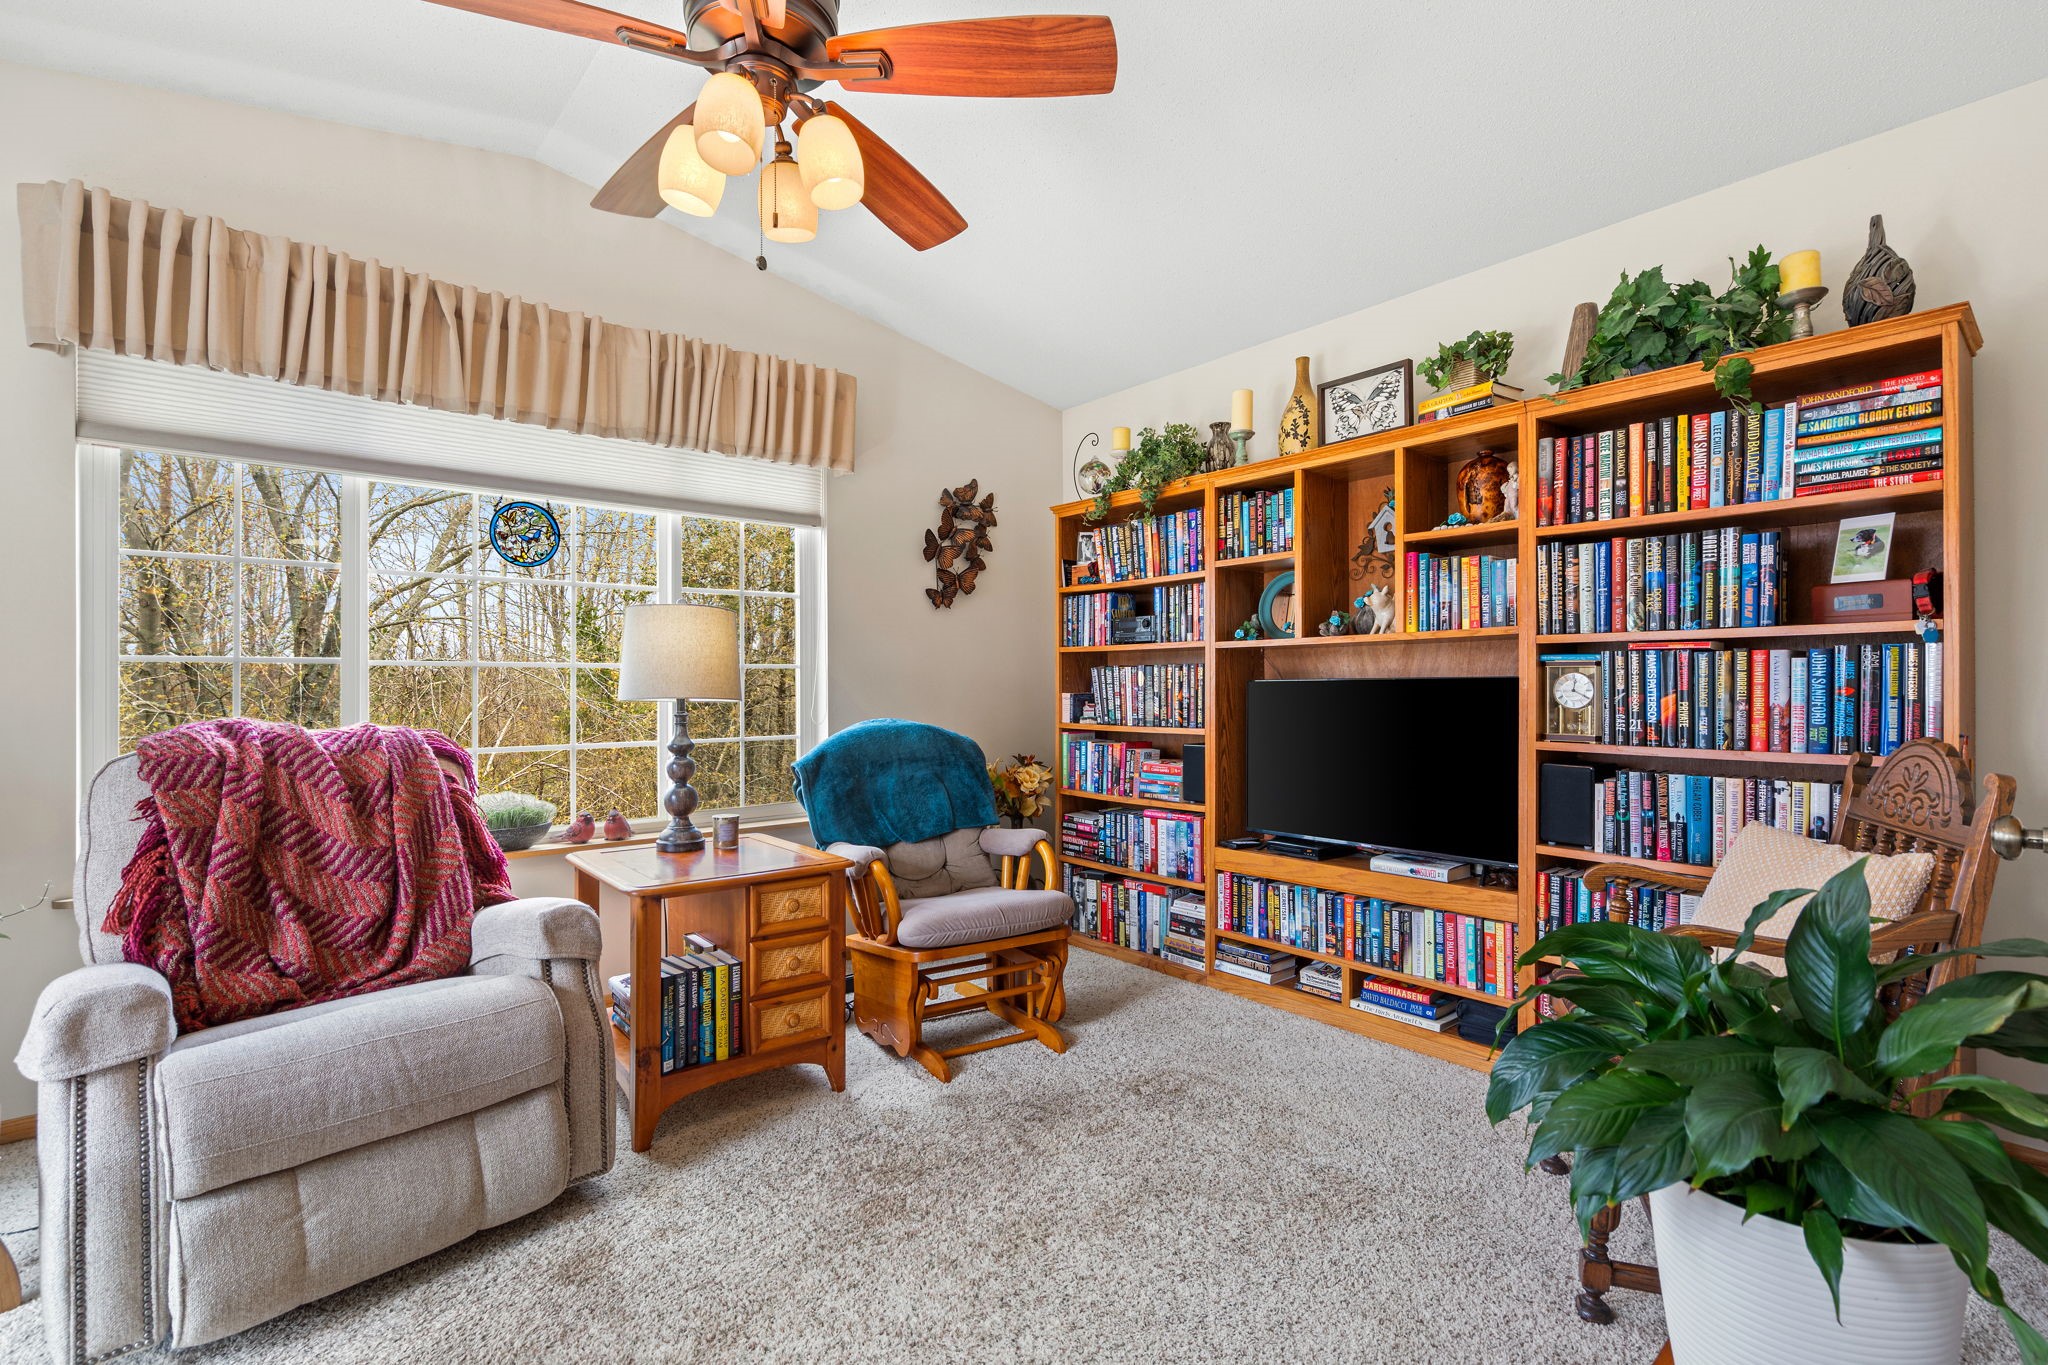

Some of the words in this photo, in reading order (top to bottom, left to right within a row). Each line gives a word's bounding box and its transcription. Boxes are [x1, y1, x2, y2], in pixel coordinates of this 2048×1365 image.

[1885, 379, 1896, 387] THE
[1898, 374, 1925, 384] HANGED
[1801, 394, 1824, 406] JOHN
[1825, 385, 1873, 399] SANDFORD
[1731, 411, 1739, 428] TAMI
[1786, 406, 1794, 417] TESS
[1807, 416, 1856, 432] SANDFORD
[1858, 408, 1894, 424] BLOODY
[1895, 401, 1932, 419] GENIUS
[1663, 422, 1671, 438] JAMES
[1694, 418, 1707, 441] JOHN
[1713, 424, 1721, 435] LEE
[1747, 415, 1760, 439] DAVID
[1768, 413, 1780, 436] DAVID
[1785, 417, 1793, 441] GERRITSEN
[1600, 434, 1610, 453] STEVE
[1617, 430, 1626, 447] DAVID
[1630, 427, 1640, 450] JAMES
[1647, 431, 1656, 449] STEPHEN
[1713, 437, 1721, 455] CHILD
[1865, 439, 1886, 450] SILENT
[1888, 432, 1928, 446] TREATMENT
[1663, 438, 1671, 465] PATTERSON
[1747, 441, 1759, 481] BALDACCI
[1767, 439, 1779, 478] BALDACCI
[1797, 448, 1824, 460] MICHAEL
[1826, 444, 1853, 456] PALMER
[1887, 447, 1921, 461] LOST
[1600, 454, 1610, 479] MARTINI
[1617, 449, 1625, 477] BALDACCI
[1631, 451, 1640, 495] PATTERSON
[1694, 443, 1707, 486] SANDFORD
[1800, 462, 1821, 474] JAMES
[1823, 457, 1860, 471] PATTERSON
[1885, 464, 1899, 473] THE
[1900, 460, 1931, 471] SOCIETY
[1554, 480, 1563, 489] R
[1811, 472, 1840, 483] MICHAEL
[1841, 468, 1868, 479] PALMER
[1873, 477, 1888, 488] THE
[1890, 474, 1914, 486] STORE
[1601, 489, 1610, 501] THE
[1693, 488, 1701, 500] PREY
[1601, 501, 1610, 514] LIST
[1615, 540, 1623, 554] JOHN
[1630, 541, 1641, 573] Catherine
[1654, 541, 1662, 572] CATHERINE
[1703, 534, 1717, 562] VORTEX
[1646, 542, 1654, 573] COULTER
[1615, 557, 1623, 582] GRISHAM
[1630, 574, 1641, 597] Coulter
[1481, 594, 1489, 613] SILENT
[1646, 592, 1654, 611] TAKE
[1654, 588, 1662, 614] DOUBLE
[1667, 583, 1675, 615] INSIDIOUS
[1686, 581, 1694, 611] ENIGMA
[1745, 606, 1753, 618] PLAY
[1631, 653, 1640, 674] JAMES
[1646, 654, 1657, 678] JAMES
[1737, 651, 1747, 670] DAVID
[1811, 652, 1827, 677] JOHN
[1871, 650, 1880, 667] TAMI
[1908, 648, 1917, 666] JAMES
[1846, 661, 1854, 679] JAMES
[1737, 671, 1747, 701] MORRELL
[1908, 667, 1917, 699] PATTERSON
[1631, 675, 1640, 712] PATTERSON
[1647, 679, 1657, 723] PATTERSON
[1811, 678, 1826, 724] SANDFORD
[1616, 714, 1625, 731] CASE
[1679, 701, 1688, 728] PRIVATE
[1737, 710, 1746, 740] SCAVENGER
[1819, 726, 1828, 743] OCEAN
[1658, 776, 1667, 796] SANDRA
[1693, 778, 1702, 801] HARLAN
[1606, 787, 1615, 816] SANDFORD
[1693, 803, 1701, 821] COBEN
[1716, 816, 1724, 826] KILL
[1659, 820, 1667, 829] THE
[1660, 829, 1668, 849] WITNESS
[1716, 839, 1724, 849] YOU
[1716, 849, 1724, 858] CAN
[1551, 876, 1560, 893] STEVE
[1551, 894, 1560, 917] MARTINI
[1446, 922, 1454, 939] DAVID
[702, 970, 711, 989] JOHN
[1362, 991, 1379, 1003] DAVID
[1380, 995, 1408, 1011] BALDACCI
[1363, 981, 1383, 991] CARL
[1388, 986, 1423, 1002] HIAASEN
[703, 990, 712, 1027] SANDFORD
